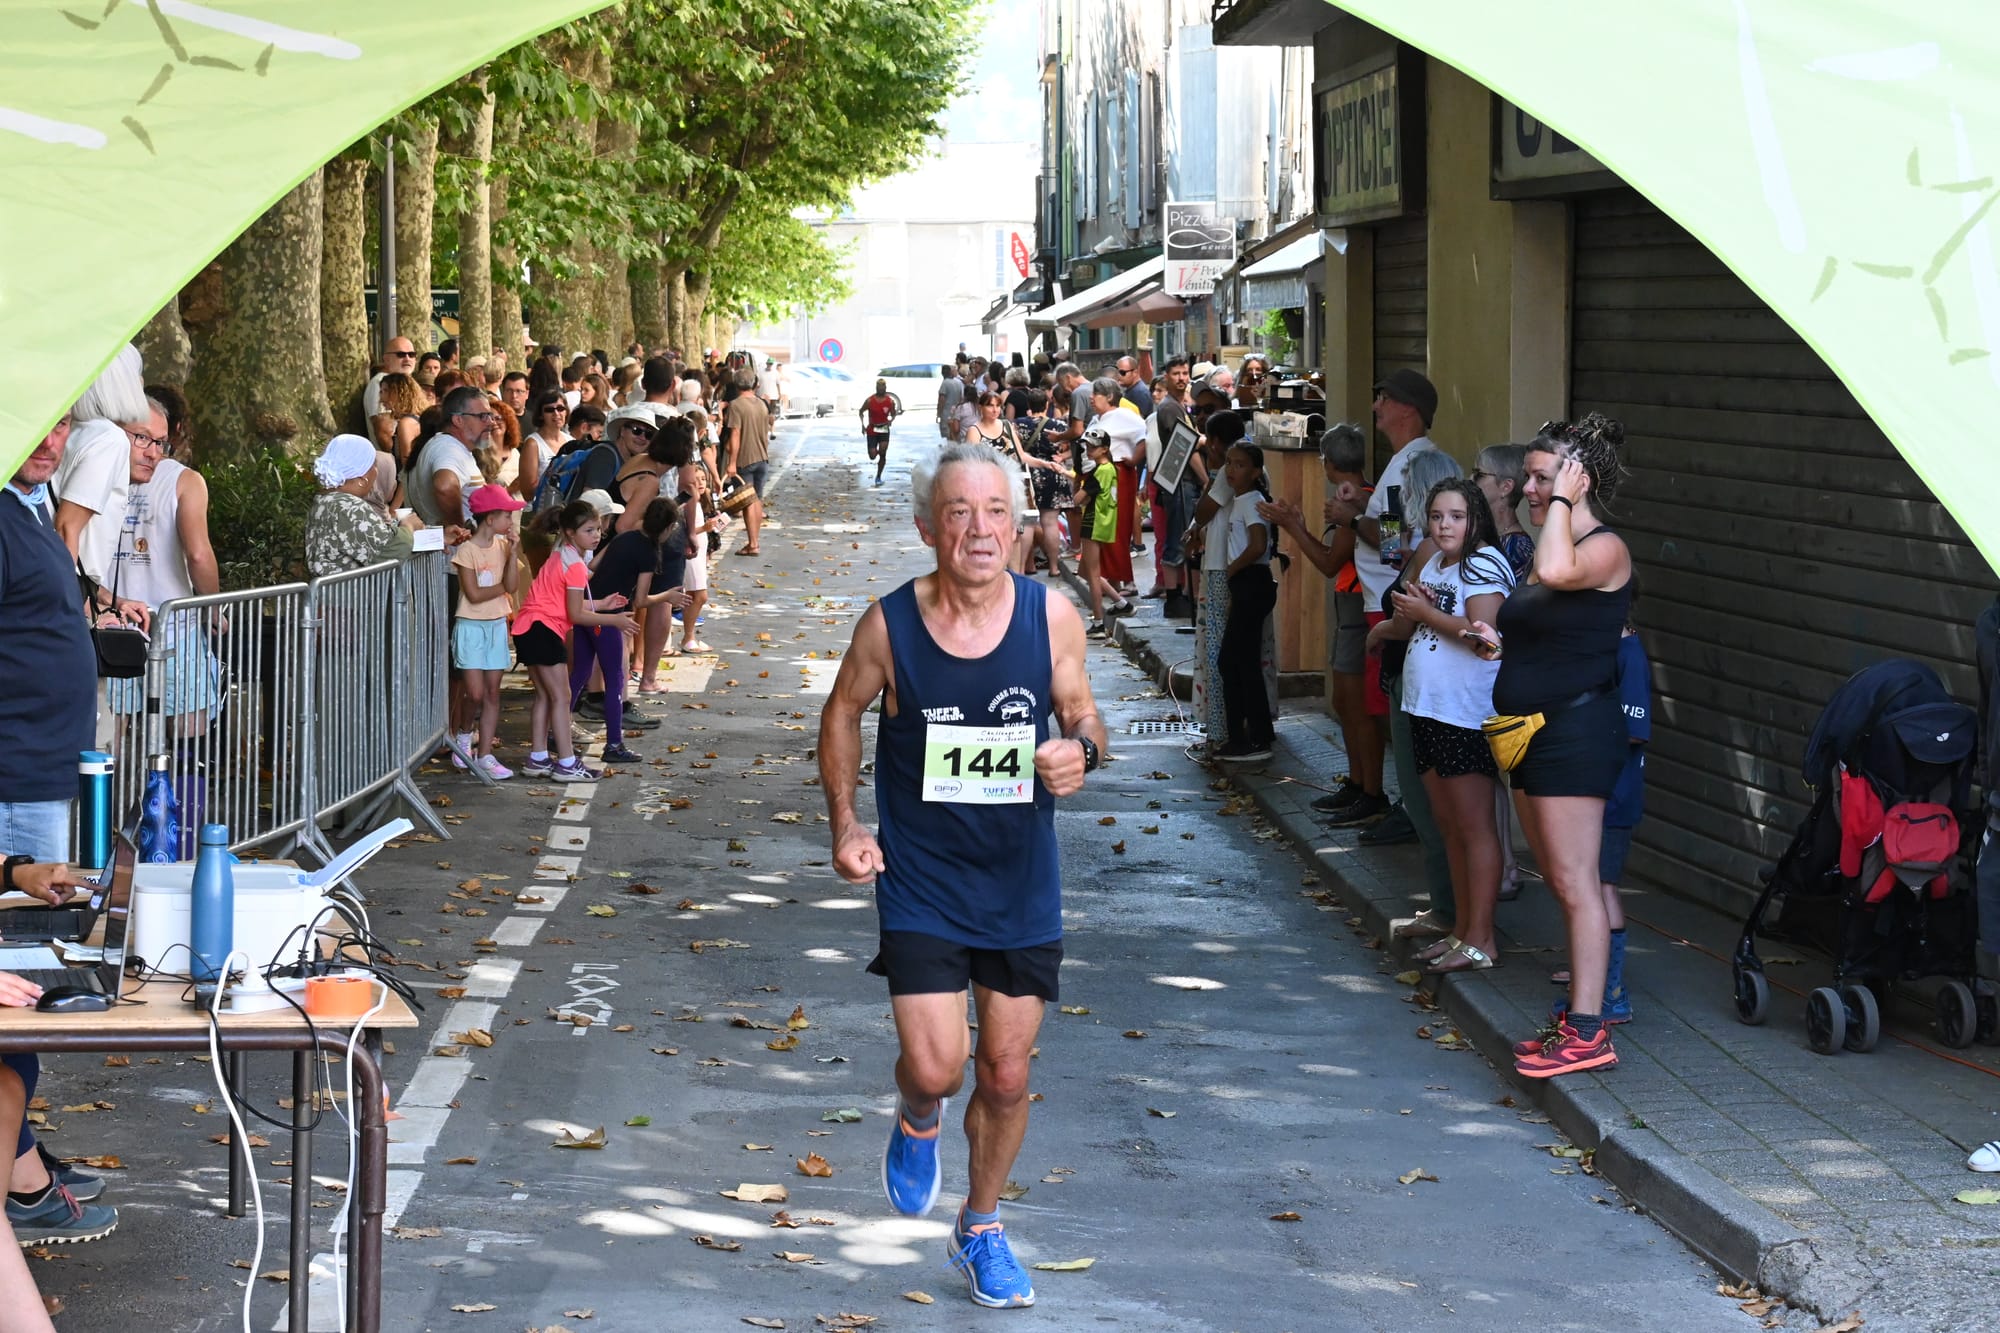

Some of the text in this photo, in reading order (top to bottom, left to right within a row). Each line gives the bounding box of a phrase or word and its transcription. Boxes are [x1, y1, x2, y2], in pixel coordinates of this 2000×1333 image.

[1170, 211, 1232, 227] Pizzeria
[1013, 239, 1026, 270] TABAC
[1009, 686, 1019, 696] DU
[943, 747, 1021, 778] 144
